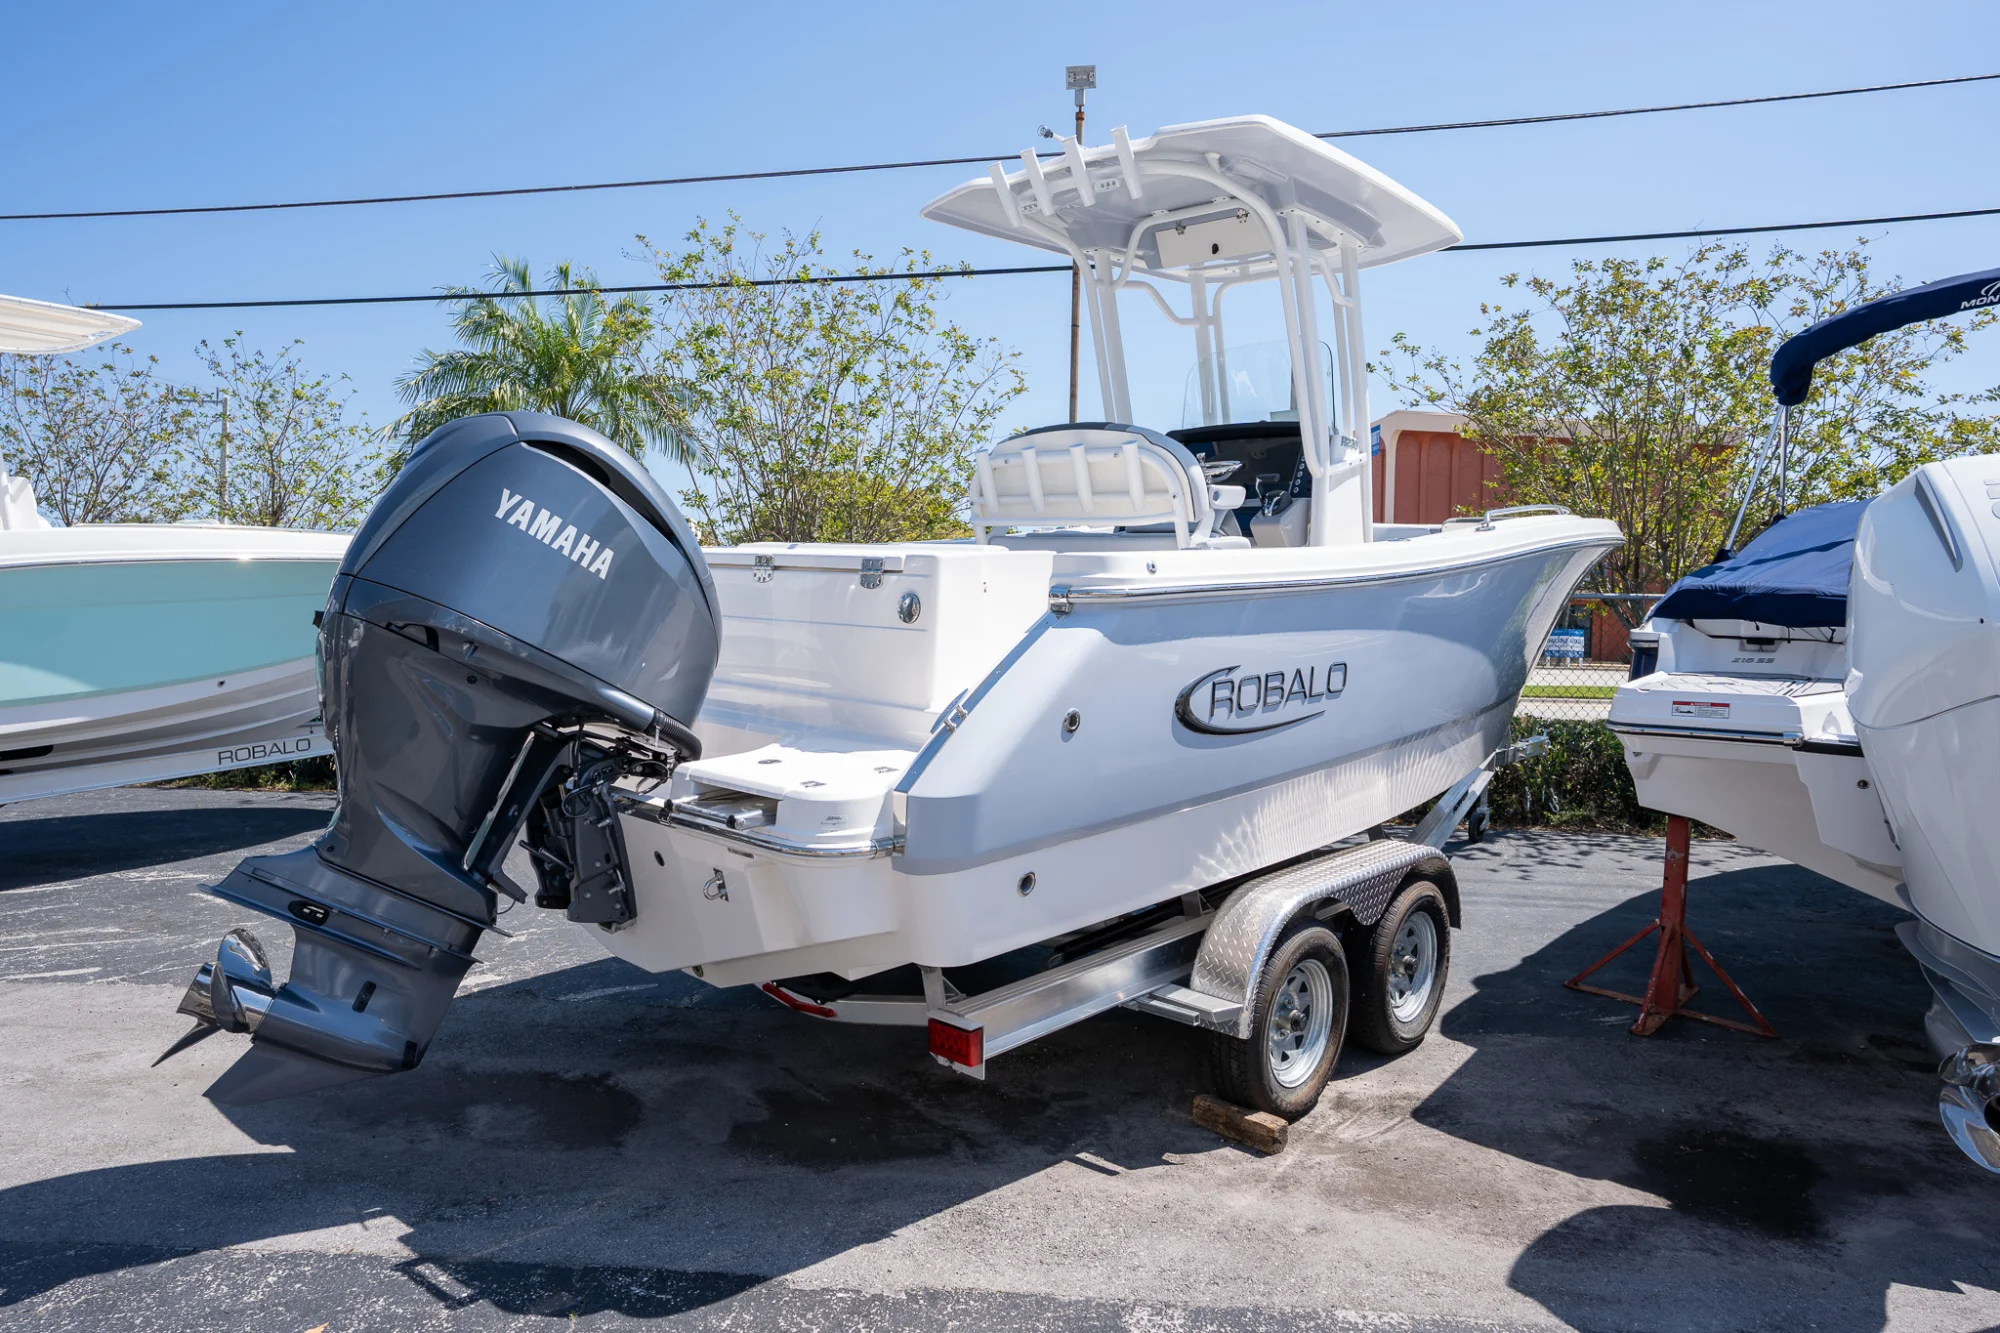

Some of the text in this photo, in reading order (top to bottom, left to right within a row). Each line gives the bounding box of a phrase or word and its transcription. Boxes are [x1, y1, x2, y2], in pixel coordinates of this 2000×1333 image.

[1960, 293, 2000, 310] MON
[495, 488, 614, 580] YAMAHA
[1211, 660, 1348, 718] ROBALO
[218, 738, 311, 765] ROBALO
